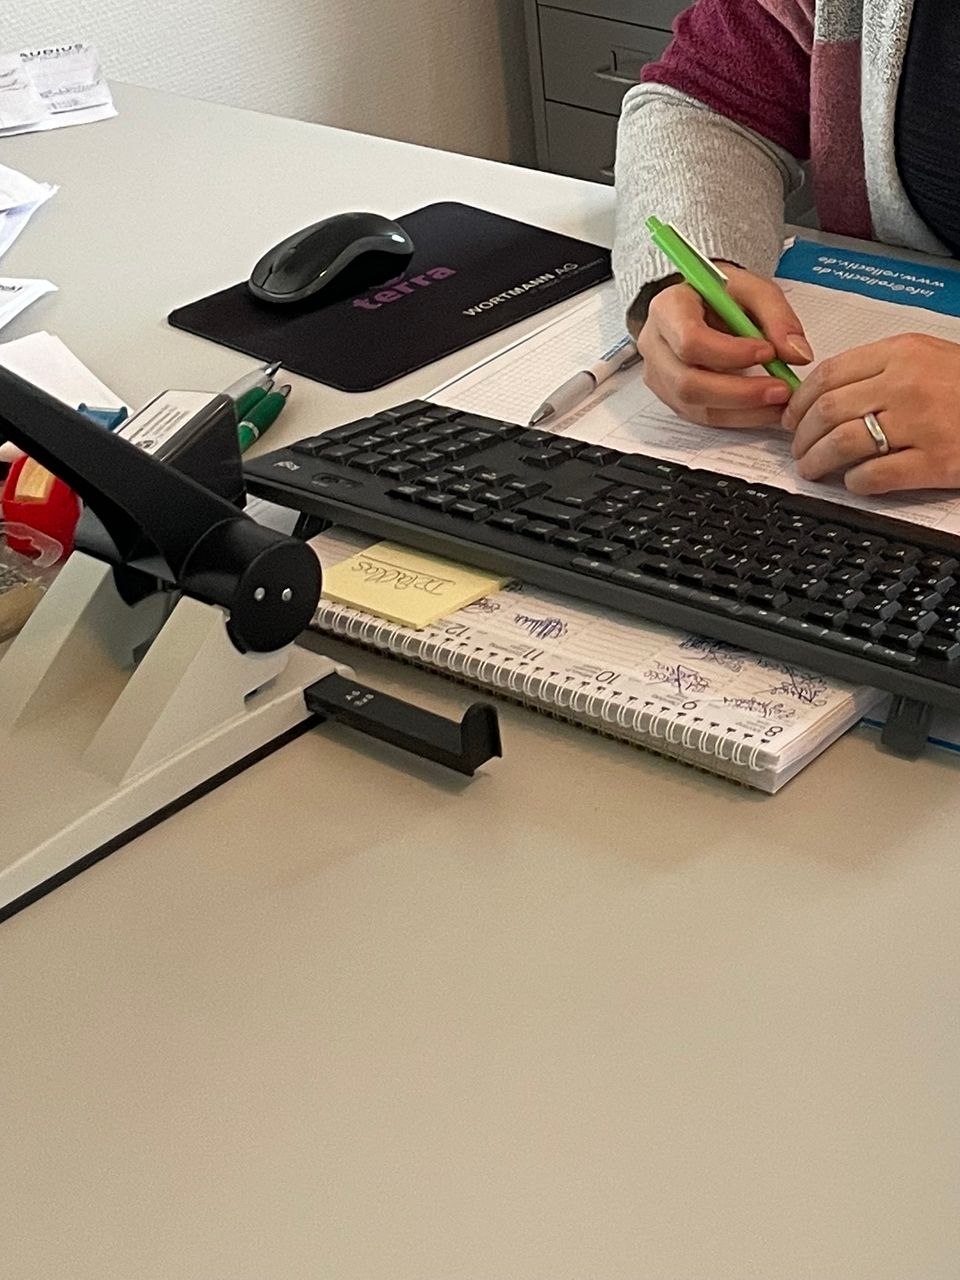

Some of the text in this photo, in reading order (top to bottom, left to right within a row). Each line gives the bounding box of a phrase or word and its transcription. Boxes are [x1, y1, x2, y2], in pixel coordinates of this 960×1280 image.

[812, 266, 934, 297] info@rollactiv.de
[817, 256, 945, 288] www.rollactiv.de
[352, 267, 457, 310] terra
[462, 271, 555, 317] WORTMANN
[554, 262, 579, 276] AG
[446, 622, 470, 637] 12
[521, 647, 545, 661] 11
[596, 670, 621, 686] 10
[764, 725, 784, 738] 8
